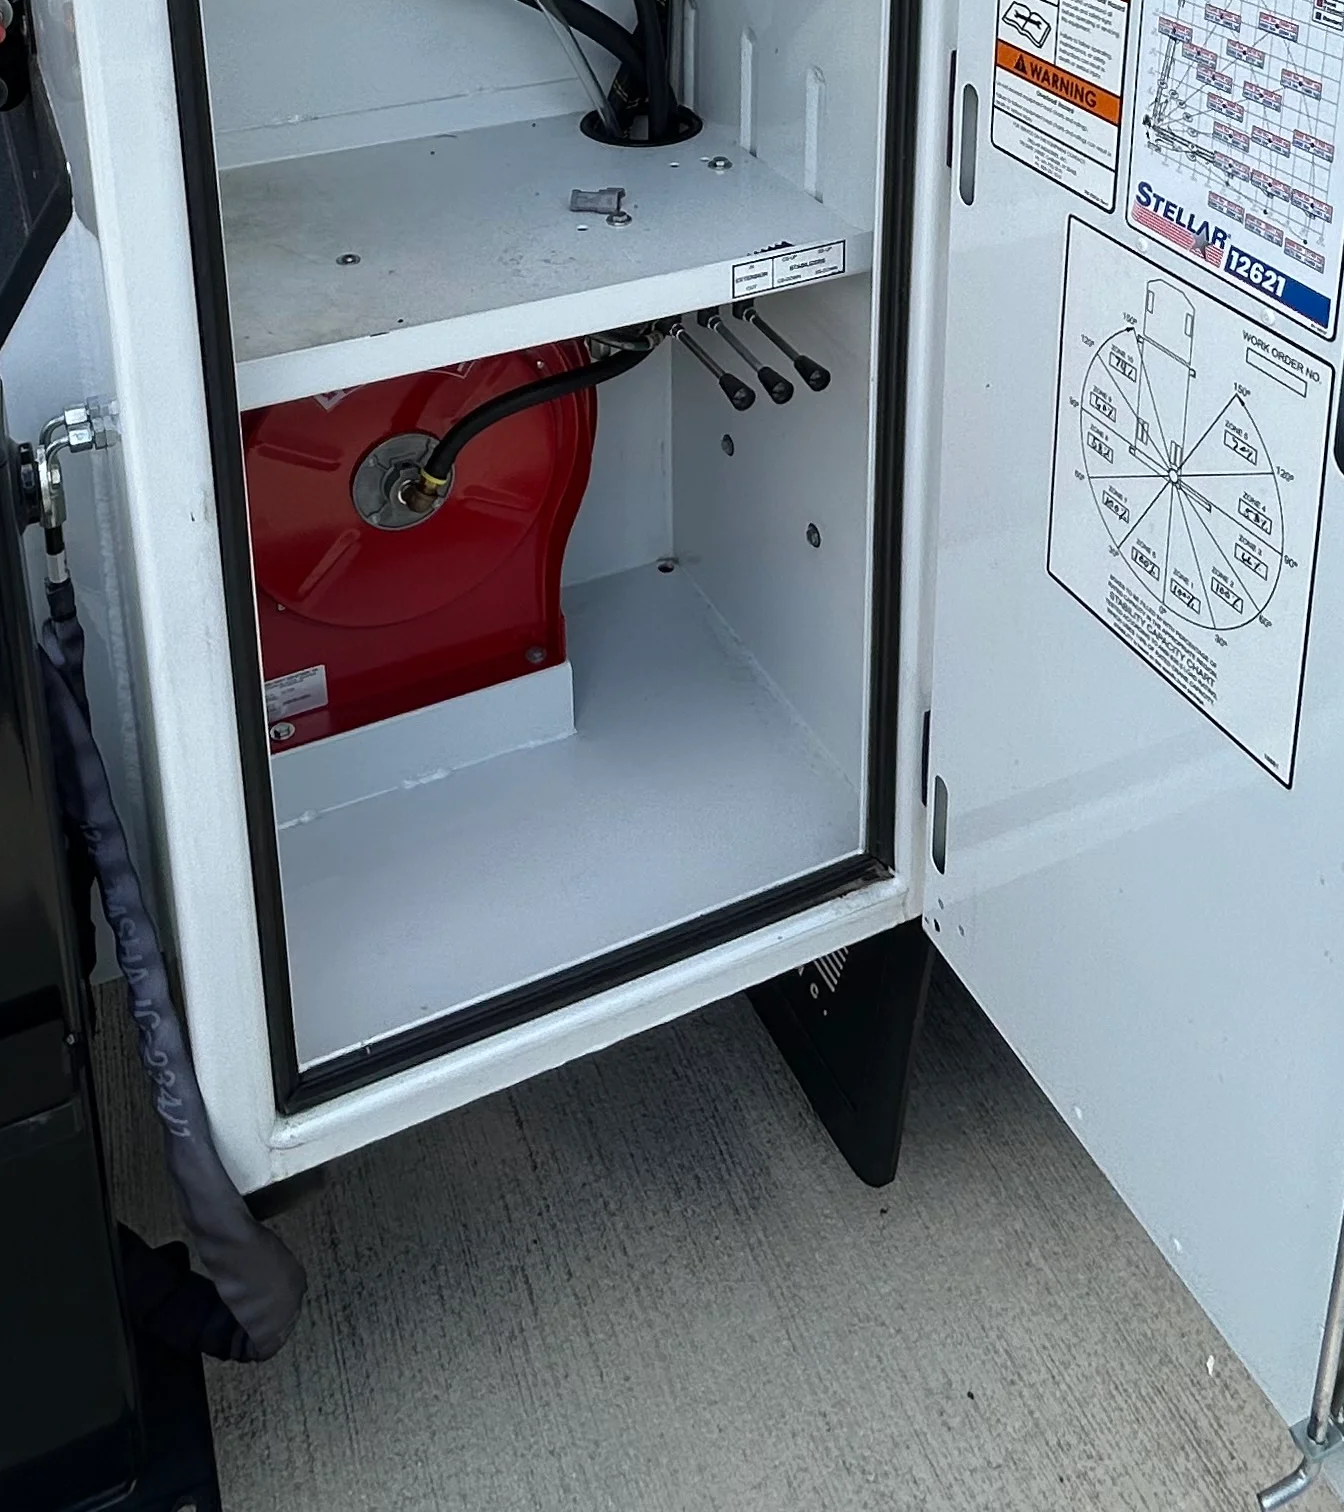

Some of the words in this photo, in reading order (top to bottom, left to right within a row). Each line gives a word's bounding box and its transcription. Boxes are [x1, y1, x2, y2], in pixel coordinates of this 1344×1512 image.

[1029, 61, 1097, 108] WARNING
[1135, 180, 1227, 250] STELLAR
[1229, 249, 1286, 298] 12621
[1242, 330, 1270, 354] WORK
[1271, 347, 1304, 374] ORDER
[1305, 367, 1322, 384] NO.
[1224, 420, 1243, 437] ZONE
[1109, 592, 1146, 626] STABILITY
[1147, 624, 1185, 660] CAPACITY
[1187, 659, 1215, 687] CHART
